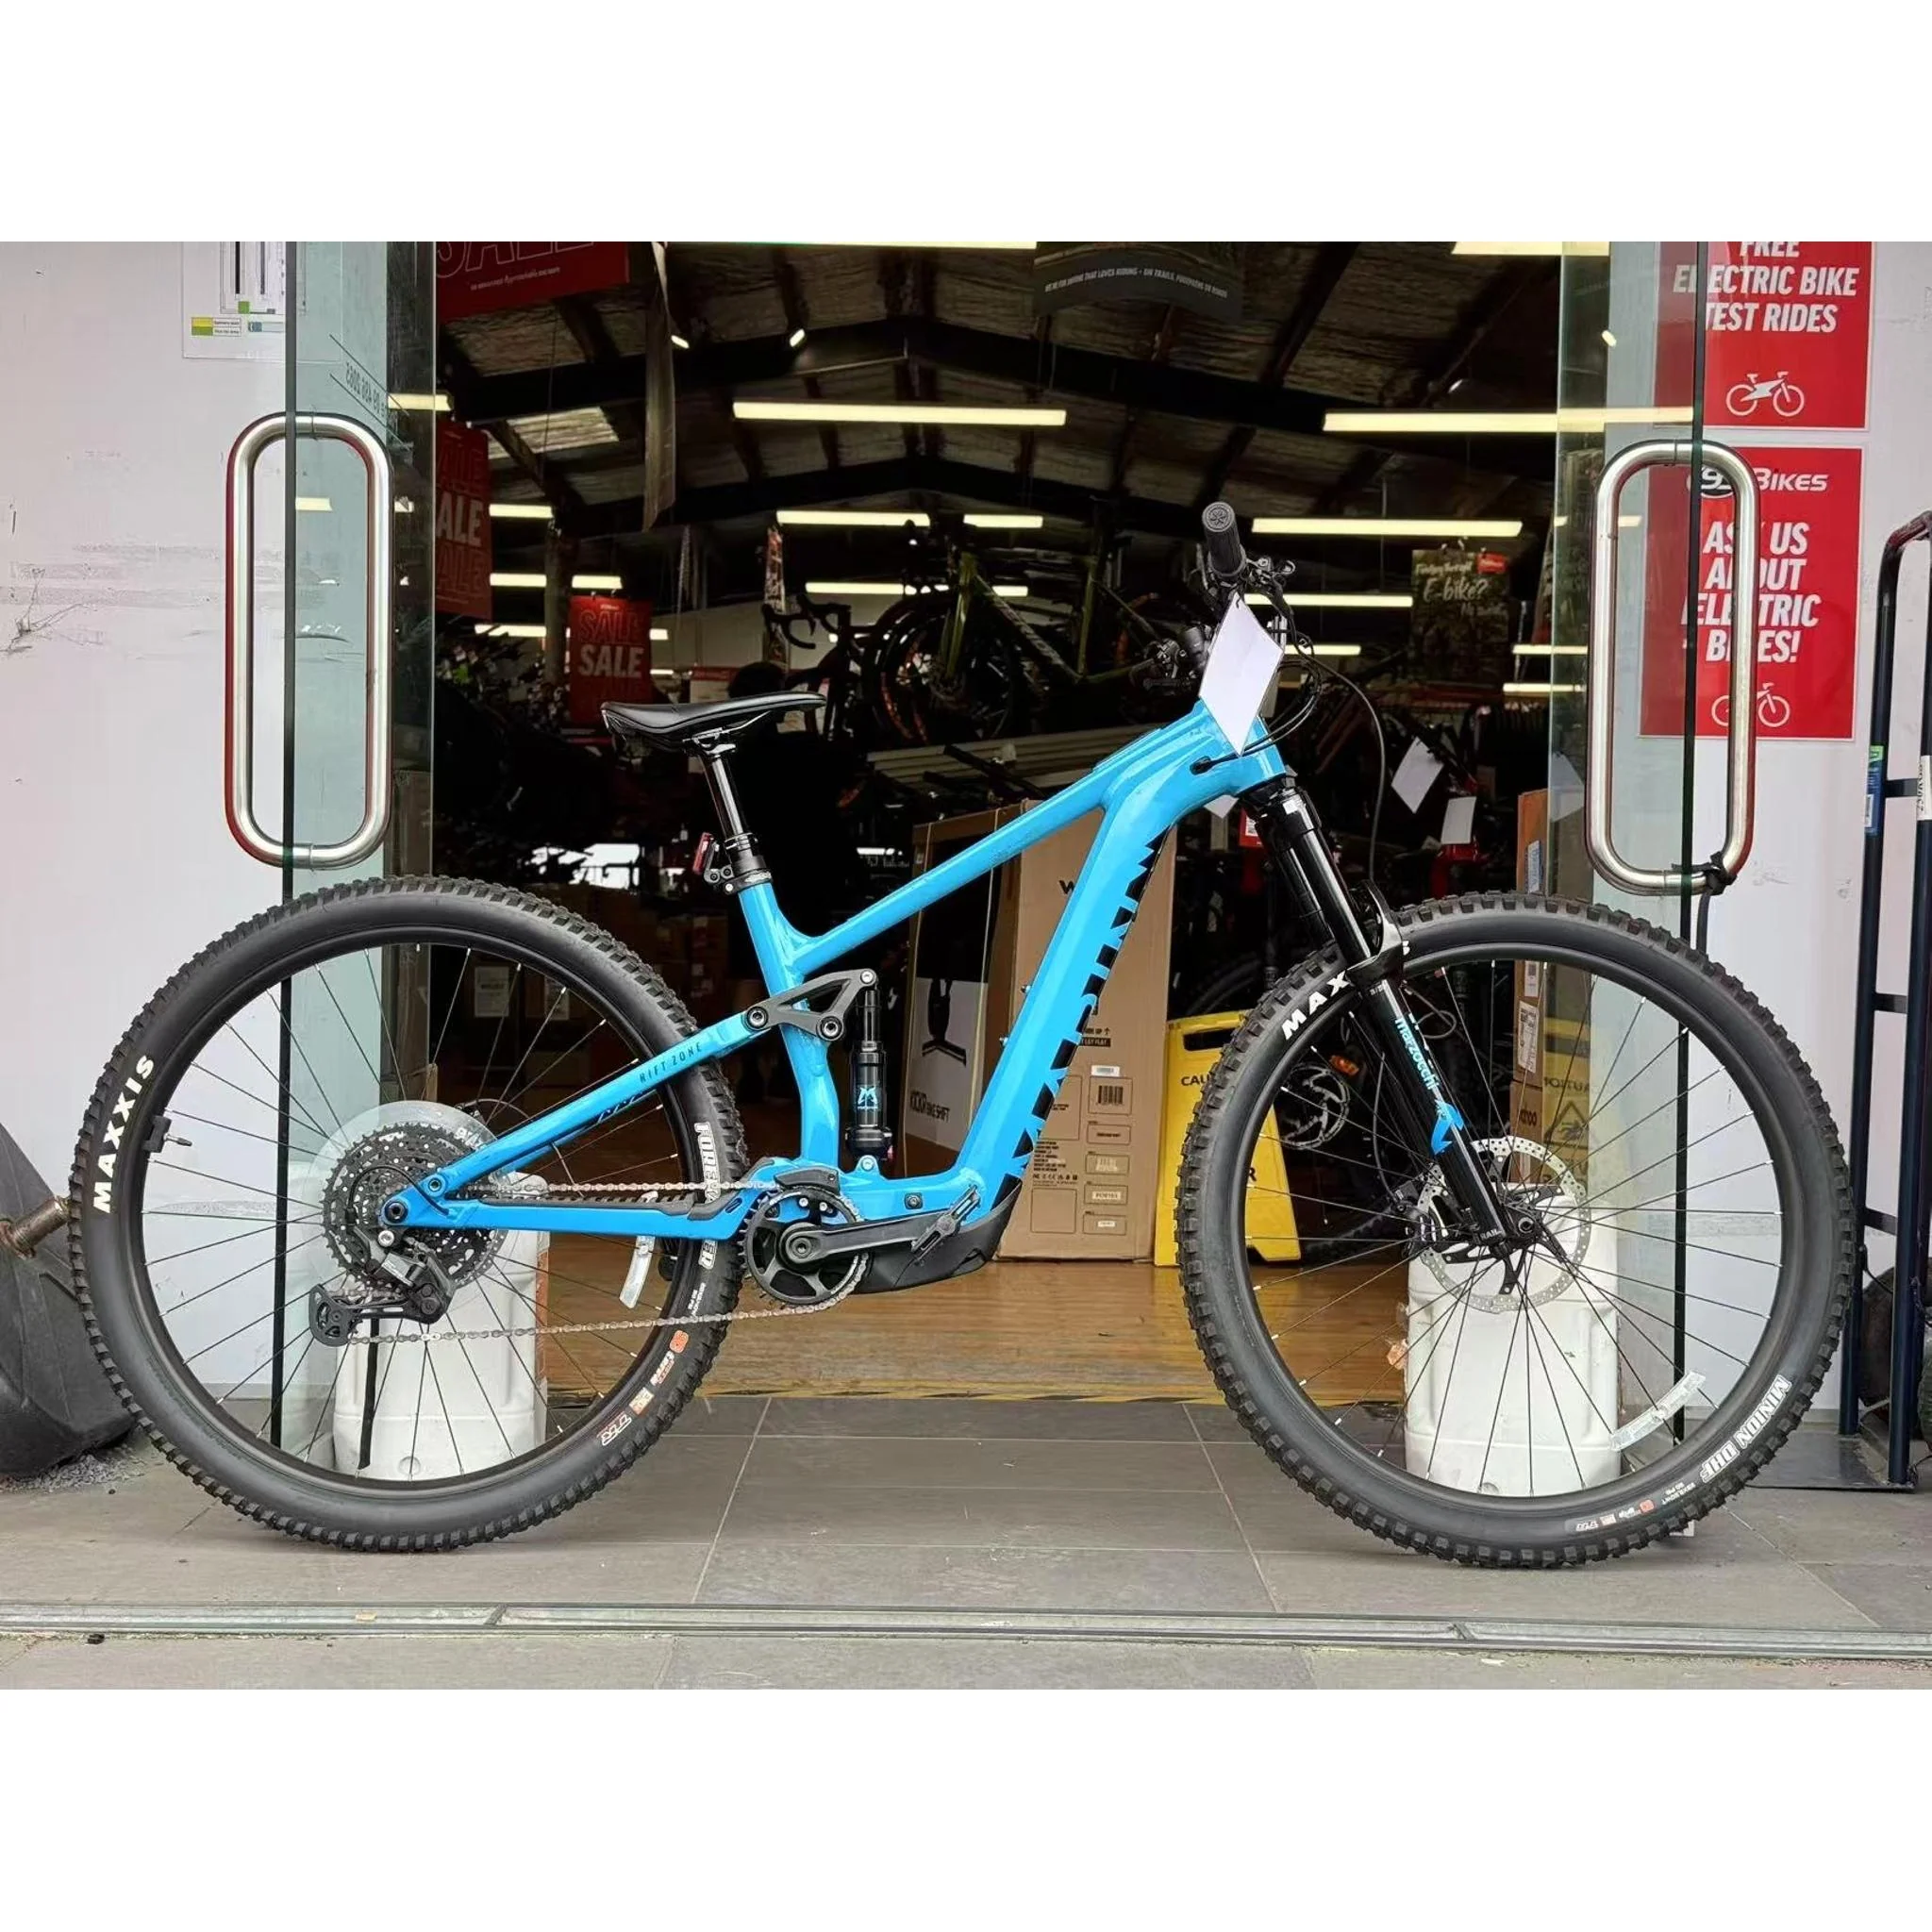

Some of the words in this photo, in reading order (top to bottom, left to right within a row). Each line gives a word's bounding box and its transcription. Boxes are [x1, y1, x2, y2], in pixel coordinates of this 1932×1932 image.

[1799, 267, 1859, 296] BIKE
[1706, 302, 1759, 332] TEST
[1762, 303, 1839, 333] RIDES
[436, 491, 484, 547] ALE
[1769, 522, 1810, 556] US
[1423, 576, 1489, 603] E-bike?
[578, 643, 644, 678] SALE
[639, 1061, 670, 1084] RIFT
[671, 1041, 702, 1066] ZONE
[1394, 1017, 1441, 1091] marzocchi
[92, 1055, 155, 1214] MAXXIS
[1734, 1374, 1792, 1449] MINION
[1699, 1441, 1740, 1484] DHF
